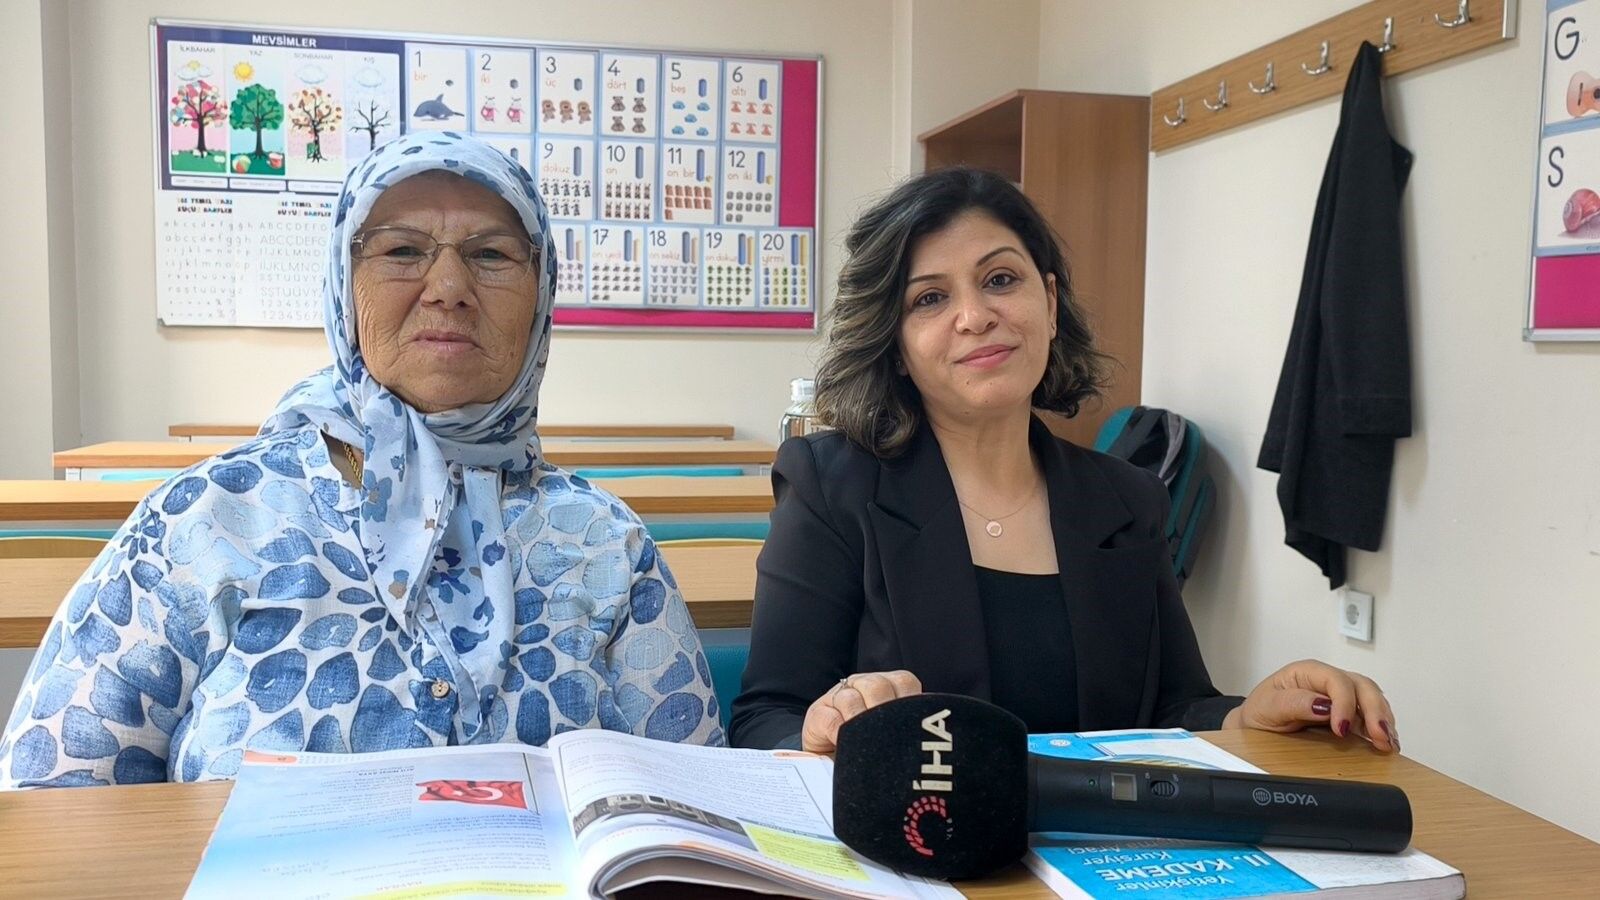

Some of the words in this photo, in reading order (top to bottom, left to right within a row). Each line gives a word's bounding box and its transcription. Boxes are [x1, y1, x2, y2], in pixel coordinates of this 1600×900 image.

[252, 34, 317, 48] MEVSİMLER
[1554, 16, 1580, 60] G
[414, 51, 422, 68] 1
[481, 53, 492, 71] 2
[545, 56, 557, 73] 3
[607, 59, 620, 76] 4
[671, 62, 682, 80] 5
[732, 66, 743, 83] 6
[607, 79, 627, 90] dört
[544, 142, 554, 159] 9
[606, 145, 626, 162] 10
[668, 147, 682, 165] 11
[728, 150, 745, 168] 12
[1548, 146, 1564, 188] S
[593, 228, 609, 245] 17
[649, 230, 667, 246] 18
[706, 232, 722, 249] 19
[763, 233, 784, 250] 20
[912, 708, 953, 792] İHA
[1273, 791, 1319, 806] BOYA
[1080, 850, 1172, 867] Kursiyer
[1095, 857, 1232, 882] KADEME
[1116, 873, 1234, 892] Yetişkinler
